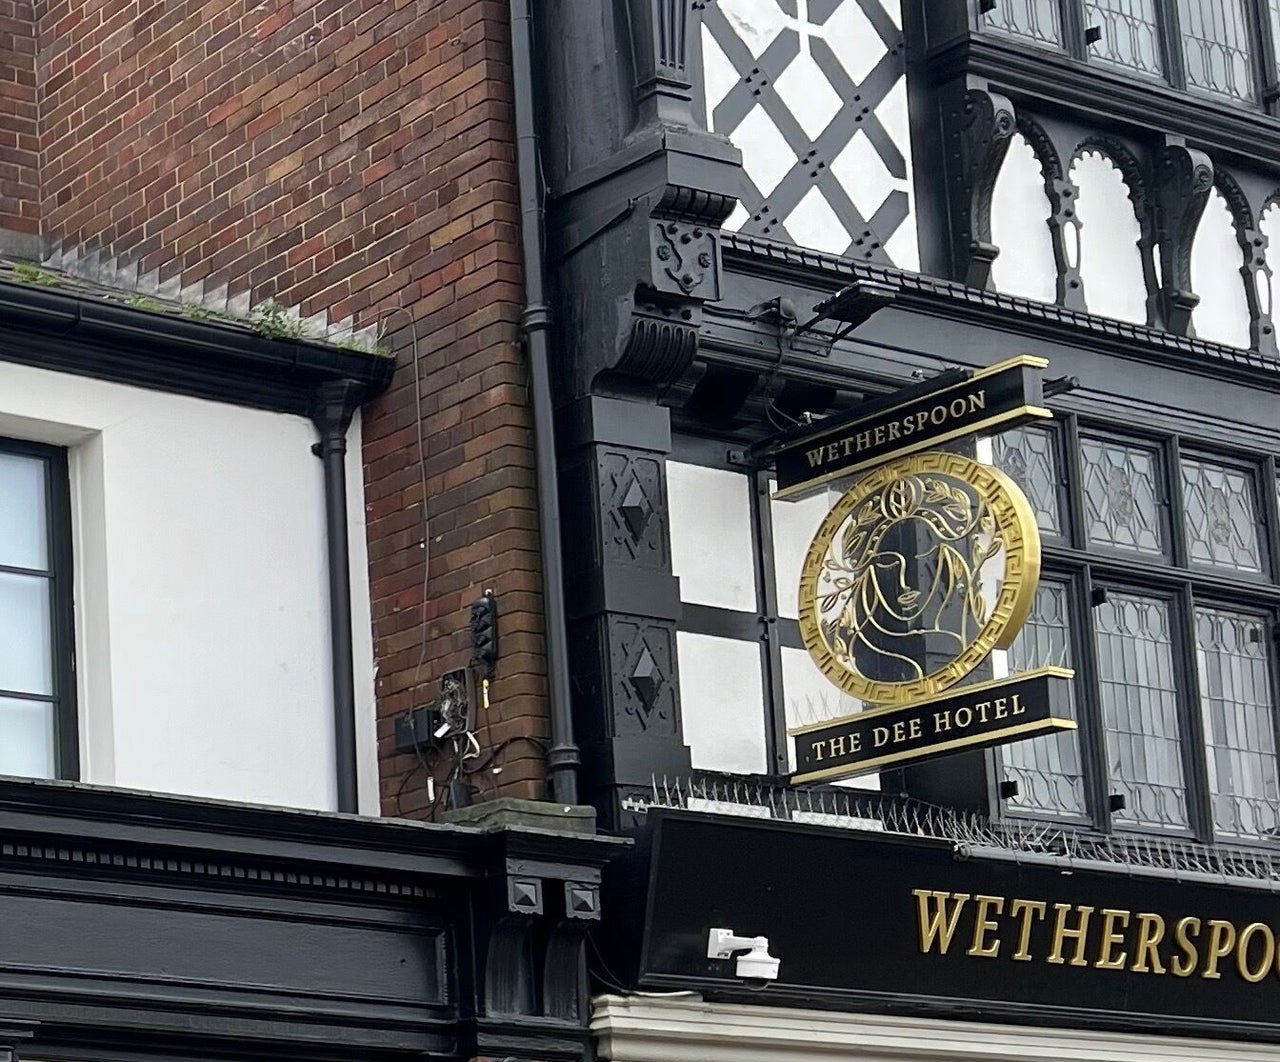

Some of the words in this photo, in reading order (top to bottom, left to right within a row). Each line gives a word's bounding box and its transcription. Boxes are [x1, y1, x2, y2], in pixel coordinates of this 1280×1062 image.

[805, 390, 986, 468] WETHERSPOON
[812, 732, 862, 761] THE
[873, 719, 922, 749] DEE
[934, 694, 1026, 732] HOTEL
[912, 888, 1280, 983] WETHERSPO
